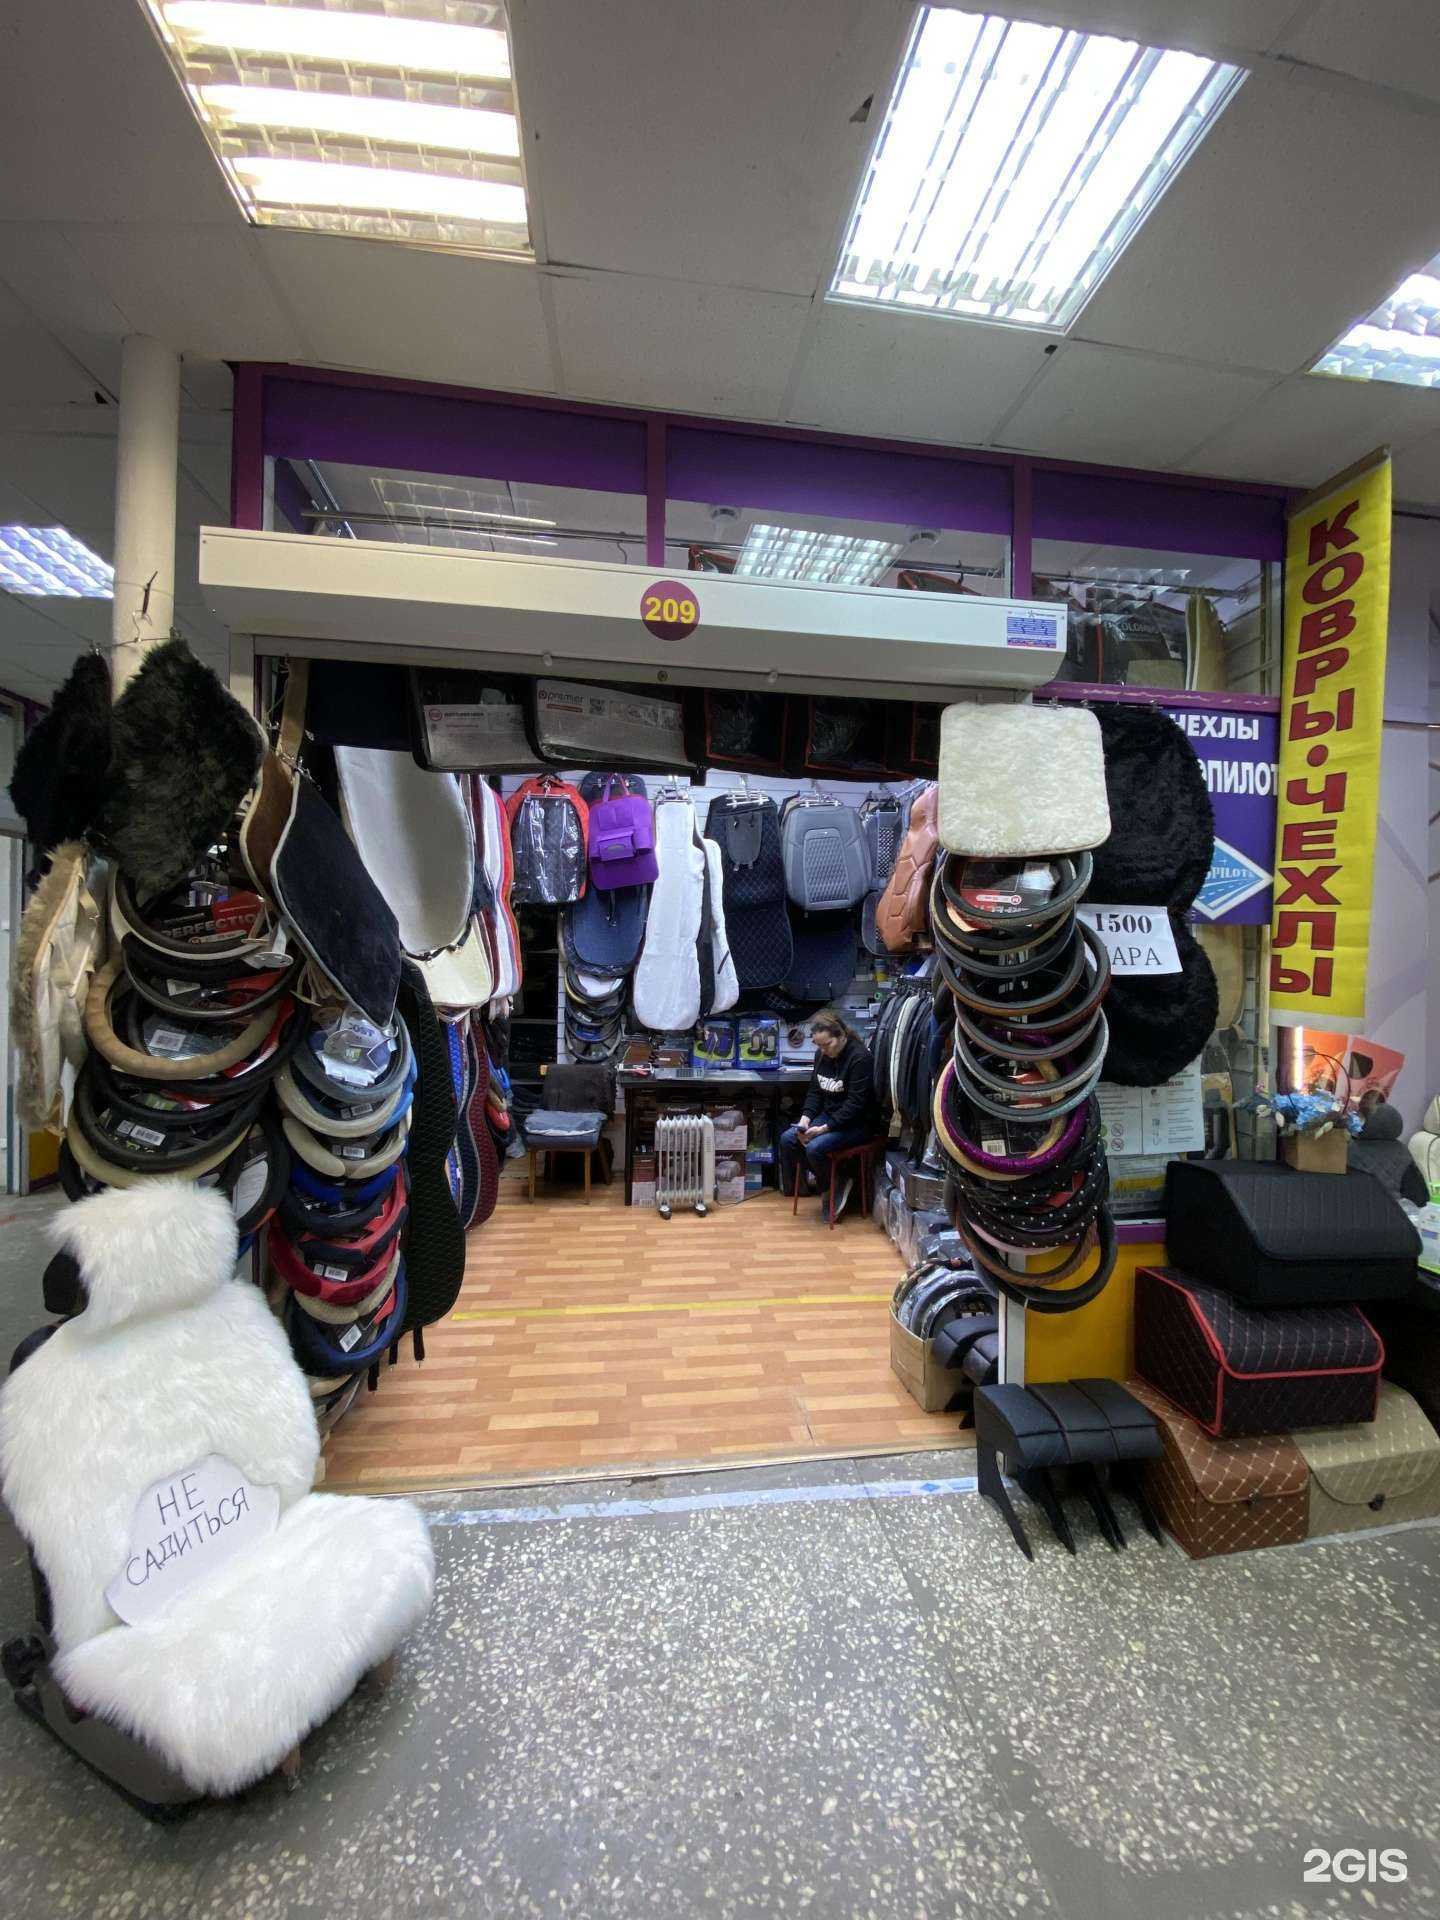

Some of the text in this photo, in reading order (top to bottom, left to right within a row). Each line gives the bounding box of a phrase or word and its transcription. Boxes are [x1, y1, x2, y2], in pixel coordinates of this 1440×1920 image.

[645, 597, 696, 624] 209
[1270, 500, 1365, 997] КОВРЫ ЧЕХЛЫ
[161, 913, 257, 938] PERFECTIO
[1096, 913, 1152, 934] 1500
[1105, 945, 1162, 967] АРА
[157, 1473, 205, 1525] НЕ
[126, 1486, 250, 1586] САДИТЬСЯ
